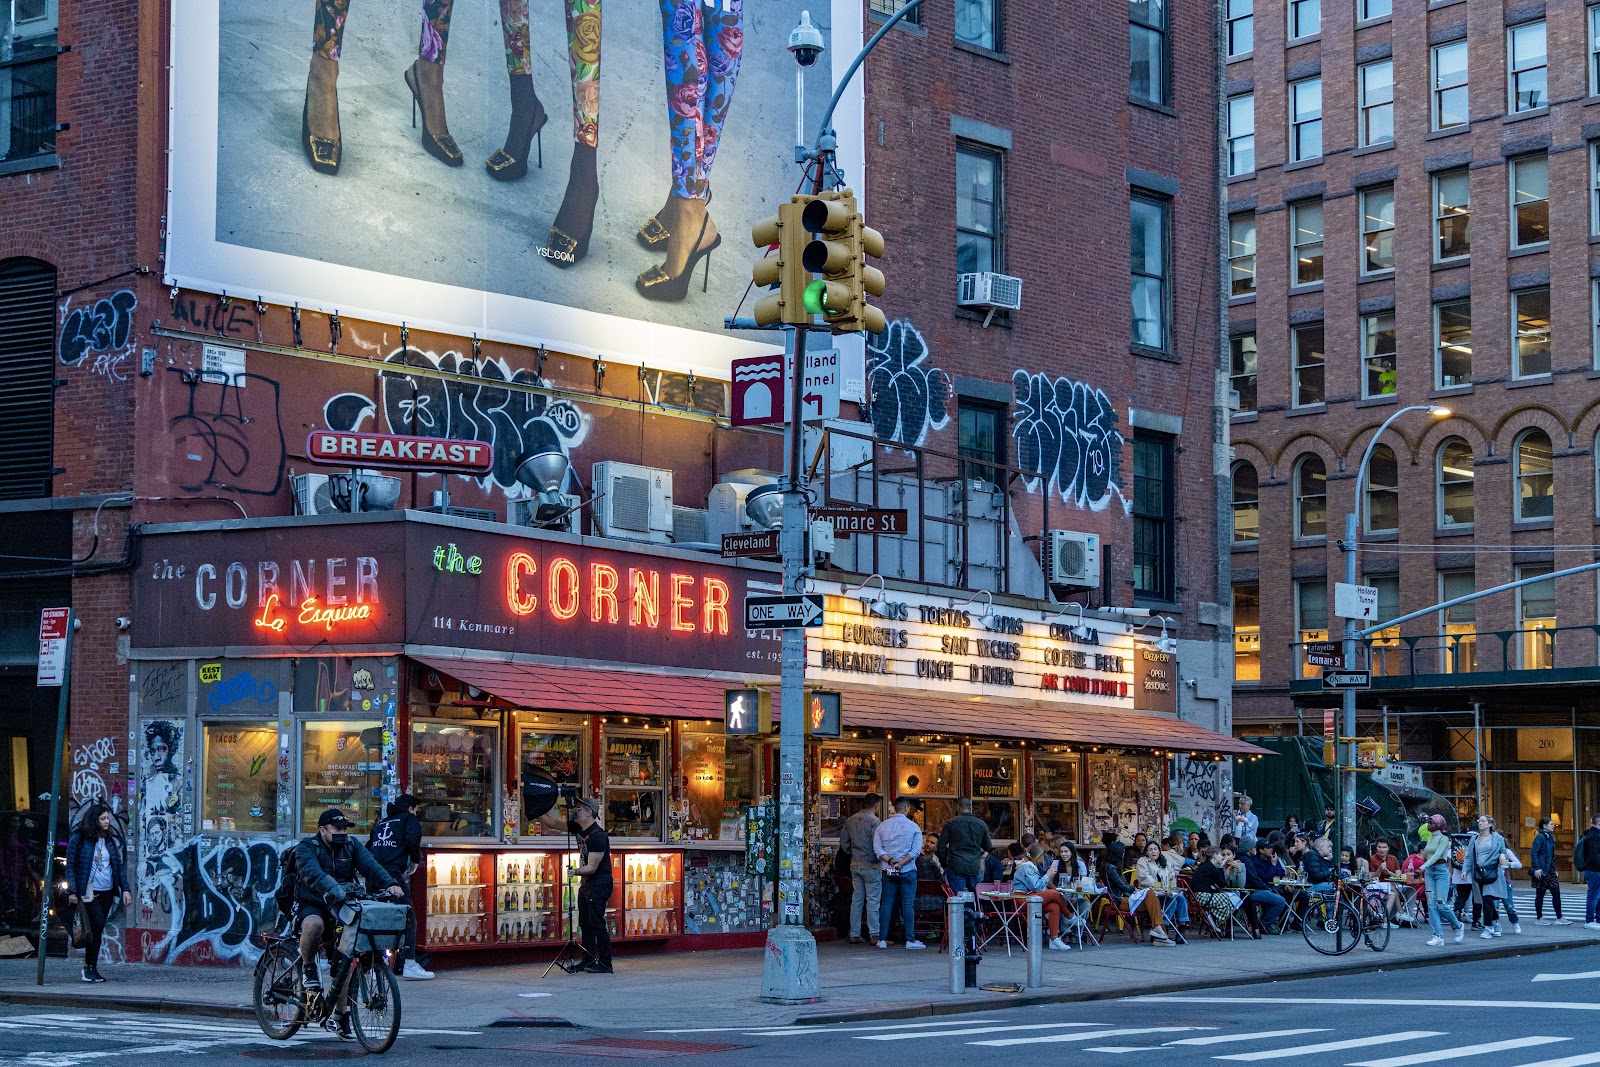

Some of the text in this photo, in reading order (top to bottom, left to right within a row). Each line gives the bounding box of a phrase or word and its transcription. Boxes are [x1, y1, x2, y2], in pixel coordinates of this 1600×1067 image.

[535, 246, 575, 263] YSL.COM
[788, 353, 837, 370] Hlland
[788, 373, 834, 388] Tnnel
[321, 436, 481, 463] BREAKFAST
[881, 514, 896, 531] St
[724, 535, 770, 550] Cleveland
[152, 556, 379, 610] the CORNER
[433, 543, 729, 635] the CORNER
[1358, 586, 1376, 596] Holland
[1359, 596, 1375, 604] Tunnel
[255, 594, 370, 631] La Esquina
[752, 604, 812, 619] ONE WAY
[920, 604, 970, 628] TORTAS
[434, 616, 515, 635] 114 Kenmare
[842, 622, 909, 648] BURGERS
[1044, 646, 1086, 669] COFFEE
[1094, 652, 1124, 674] BEER
[1308, 644, 1335, 653] Lafayette
[746, 651, 764, 660] est.
[1308, 654, 1340, 666] Kenmare St
[822, 648, 887, 674] BREAKFA
[917, 658, 954, 682] UNCH
[215, 734, 238, 744] TACOS
[1538, 740, 1554, 749] 200
[844, 756, 862, 766] TACOS
[903, 756, 926, 767] POZOLE
[975, 768, 994, 778] POLLO
[1036, 768, 1057, 776] TORTAS
[1390, 772, 1405, 780] LEACH
[926, 784, 951, 794] CEVICHE
[980, 785, 1012, 795] ROSTIZADO
